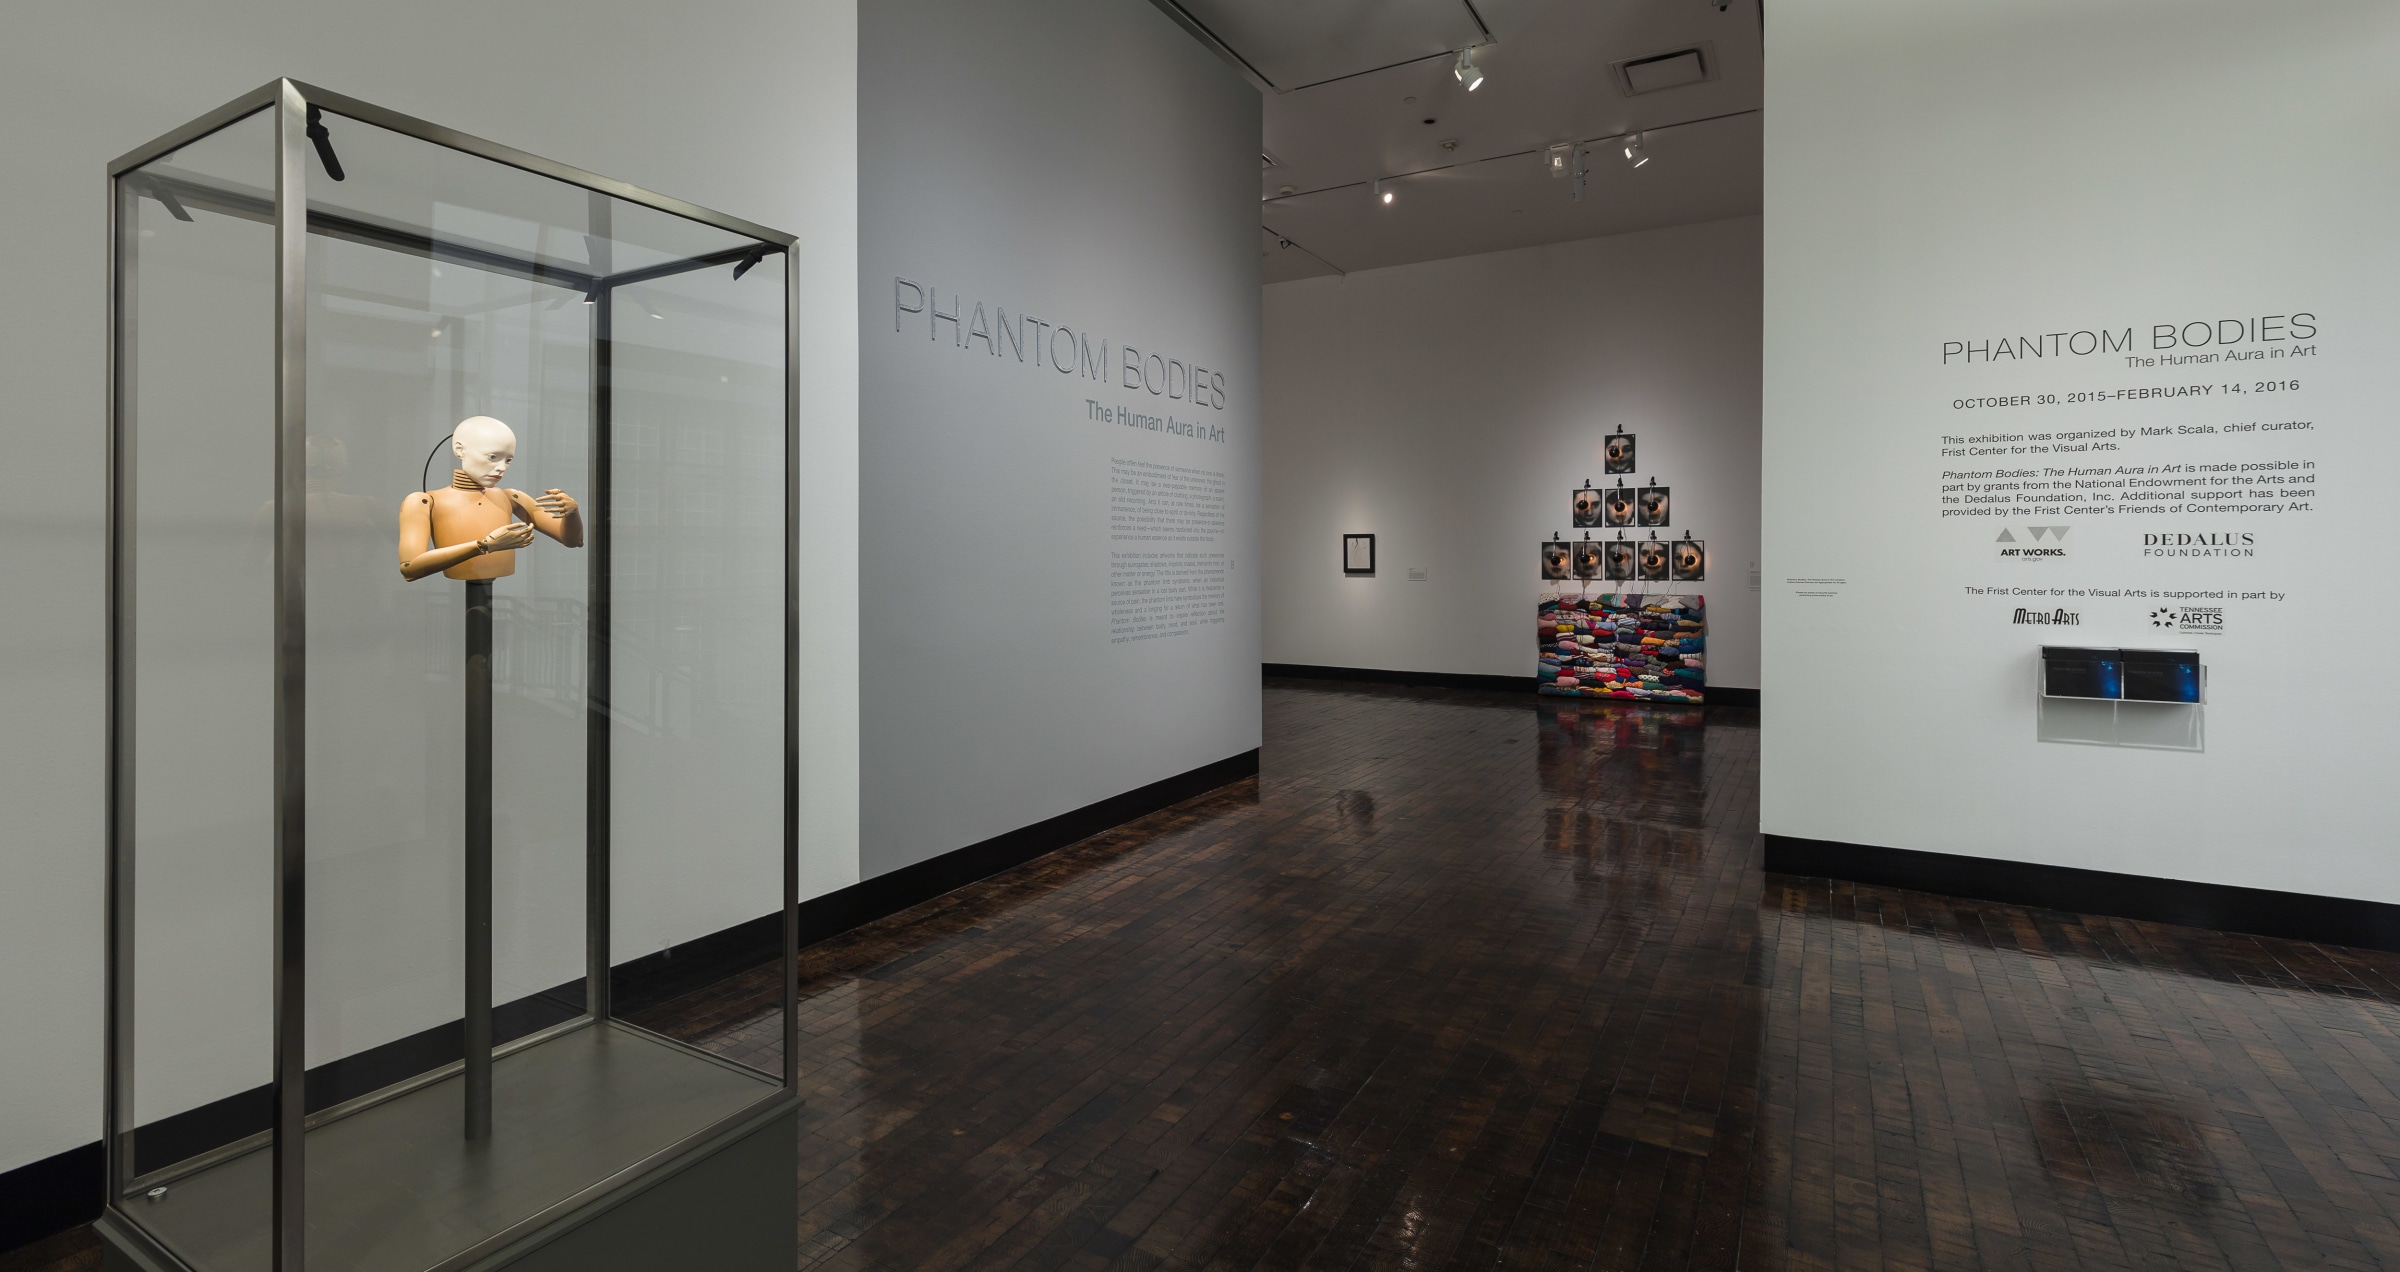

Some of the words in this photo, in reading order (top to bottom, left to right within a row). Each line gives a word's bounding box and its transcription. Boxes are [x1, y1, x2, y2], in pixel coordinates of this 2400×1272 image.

[894, 276, 1108, 383] PHANTOM
[1122, 344, 1226, 410] BODIES
[1944, 328, 2132, 365] PHANTOM
[2153, 313, 2316, 350] BODIES
[2124, 356, 2155, 368] The
[2160, 354, 2219, 366] Human
[2224, 350, 2265, 362] Aura
[2270, 347, 2284, 358] in
[2290, 345, 2316, 357] Art
[1953, 396, 2030, 409] OCTOBER
[2037, 394, 2060, 405] 30,
[2221, 383, 2246, 395] 14,
[2255, 380, 2300, 392] 2016
[1085, 399, 1113, 423] The
[1116, 405, 1163, 432] Human
[1167, 415, 1194, 438] Aura
[1197, 422, 1206, 439] in
[1209, 425, 1225, 443] Art
[1941, 436, 1964, 444] This
[1968, 433, 2024, 443] exhibition
[2056, 428, 2116, 441] organized
[2120, 428, 2136, 438] by
[2141, 426, 2173, 436] Mark
[2178, 424, 2218, 434] Scala,
[2224, 422, 2256, 432] chief
[2262, 421, 2314, 431] curator,
[1942, 448, 1966, 456] Frist
[1969, 447, 2008, 456] Center
[2010, 446, 2027, 454] for
[2030, 444, 2049, 453] the
[2052, 442, 2088, 452] Visual
[2092, 442, 2120, 451] Arts.
[1942, 471, 1992, 480] Phantom
[1996, 469, 2039, 478] Bodies:
[2043, 468, 2064, 476] The
[2068, 467, 2112, 476] Human
[2114, 466, 2144, 474] Aura
[2148, 465, 2158, 474] in
[2161, 464, 2182, 473] Art
[2185, 464, 2196, 472] is
[2200, 462, 2237, 472] made
[2241, 460, 2299, 473] possible
[2303, 460, 2315, 469] in
[1942, 483, 1964, 494] part
[1967, 483, 1981, 493] by
[1984, 482, 2020, 492] grants
[2023, 481, 2049, 490] from
[2052, 480, 2072, 489] the
[2075, 478, 2125, 488] National
[2129, 477, 2207, 487] Endowment
[2210, 476, 2229, 485] for
[2232, 476, 2253, 484] the
[2256, 475, 2285, 484] Arts
[2288, 474, 2315, 483] and
[1942, 496, 1960, 504] the
[1965, 494, 2011, 503] Dedalus
[2016, 493, 2086, 502] Foundation,
[2093, 492, 2114, 501] Inc.
[2120, 490, 2184, 500] Additional
[2190, 490, 2243, 501] support
[2249, 489, 2274, 498] has
[2280, 488, 2315, 497] been
[1942, 507, 1991, 518] provided
[1995, 507, 2009, 517] by
[2012, 506, 2030, 515] the
[2034, 506, 2060, 514] Frist
[2119, 504, 2166, 514] Friends
[2170, 504, 2183, 513] of
[2186, 504, 2284, 514] Contemporary
[2288, 502, 2313, 511] Art.
[2143, 533, 2254, 546] DEDALUS
[2022, 548, 2066, 556] WORKS.
[2144, 548, 2253, 556] FOUNDATION
[1987, 587, 2009, 595] Frist
[2012, 587, 2048, 596] Center
[2050, 588, 2065, 596] for
[2068, 588, 2085, 596] the
[2088, 588, 2120, 597] Visual
[2124, 589, 2147, 597] Arts
[2150, 589, 2160, 598] is
[2163, 590, 2223, 600] supported
[2228, 590, 2238, 598] in
[2242, 591, 2266, 600] part
[2270, 591, 2285, 601] by
[2179, 614, 2223, 624] ARTS
